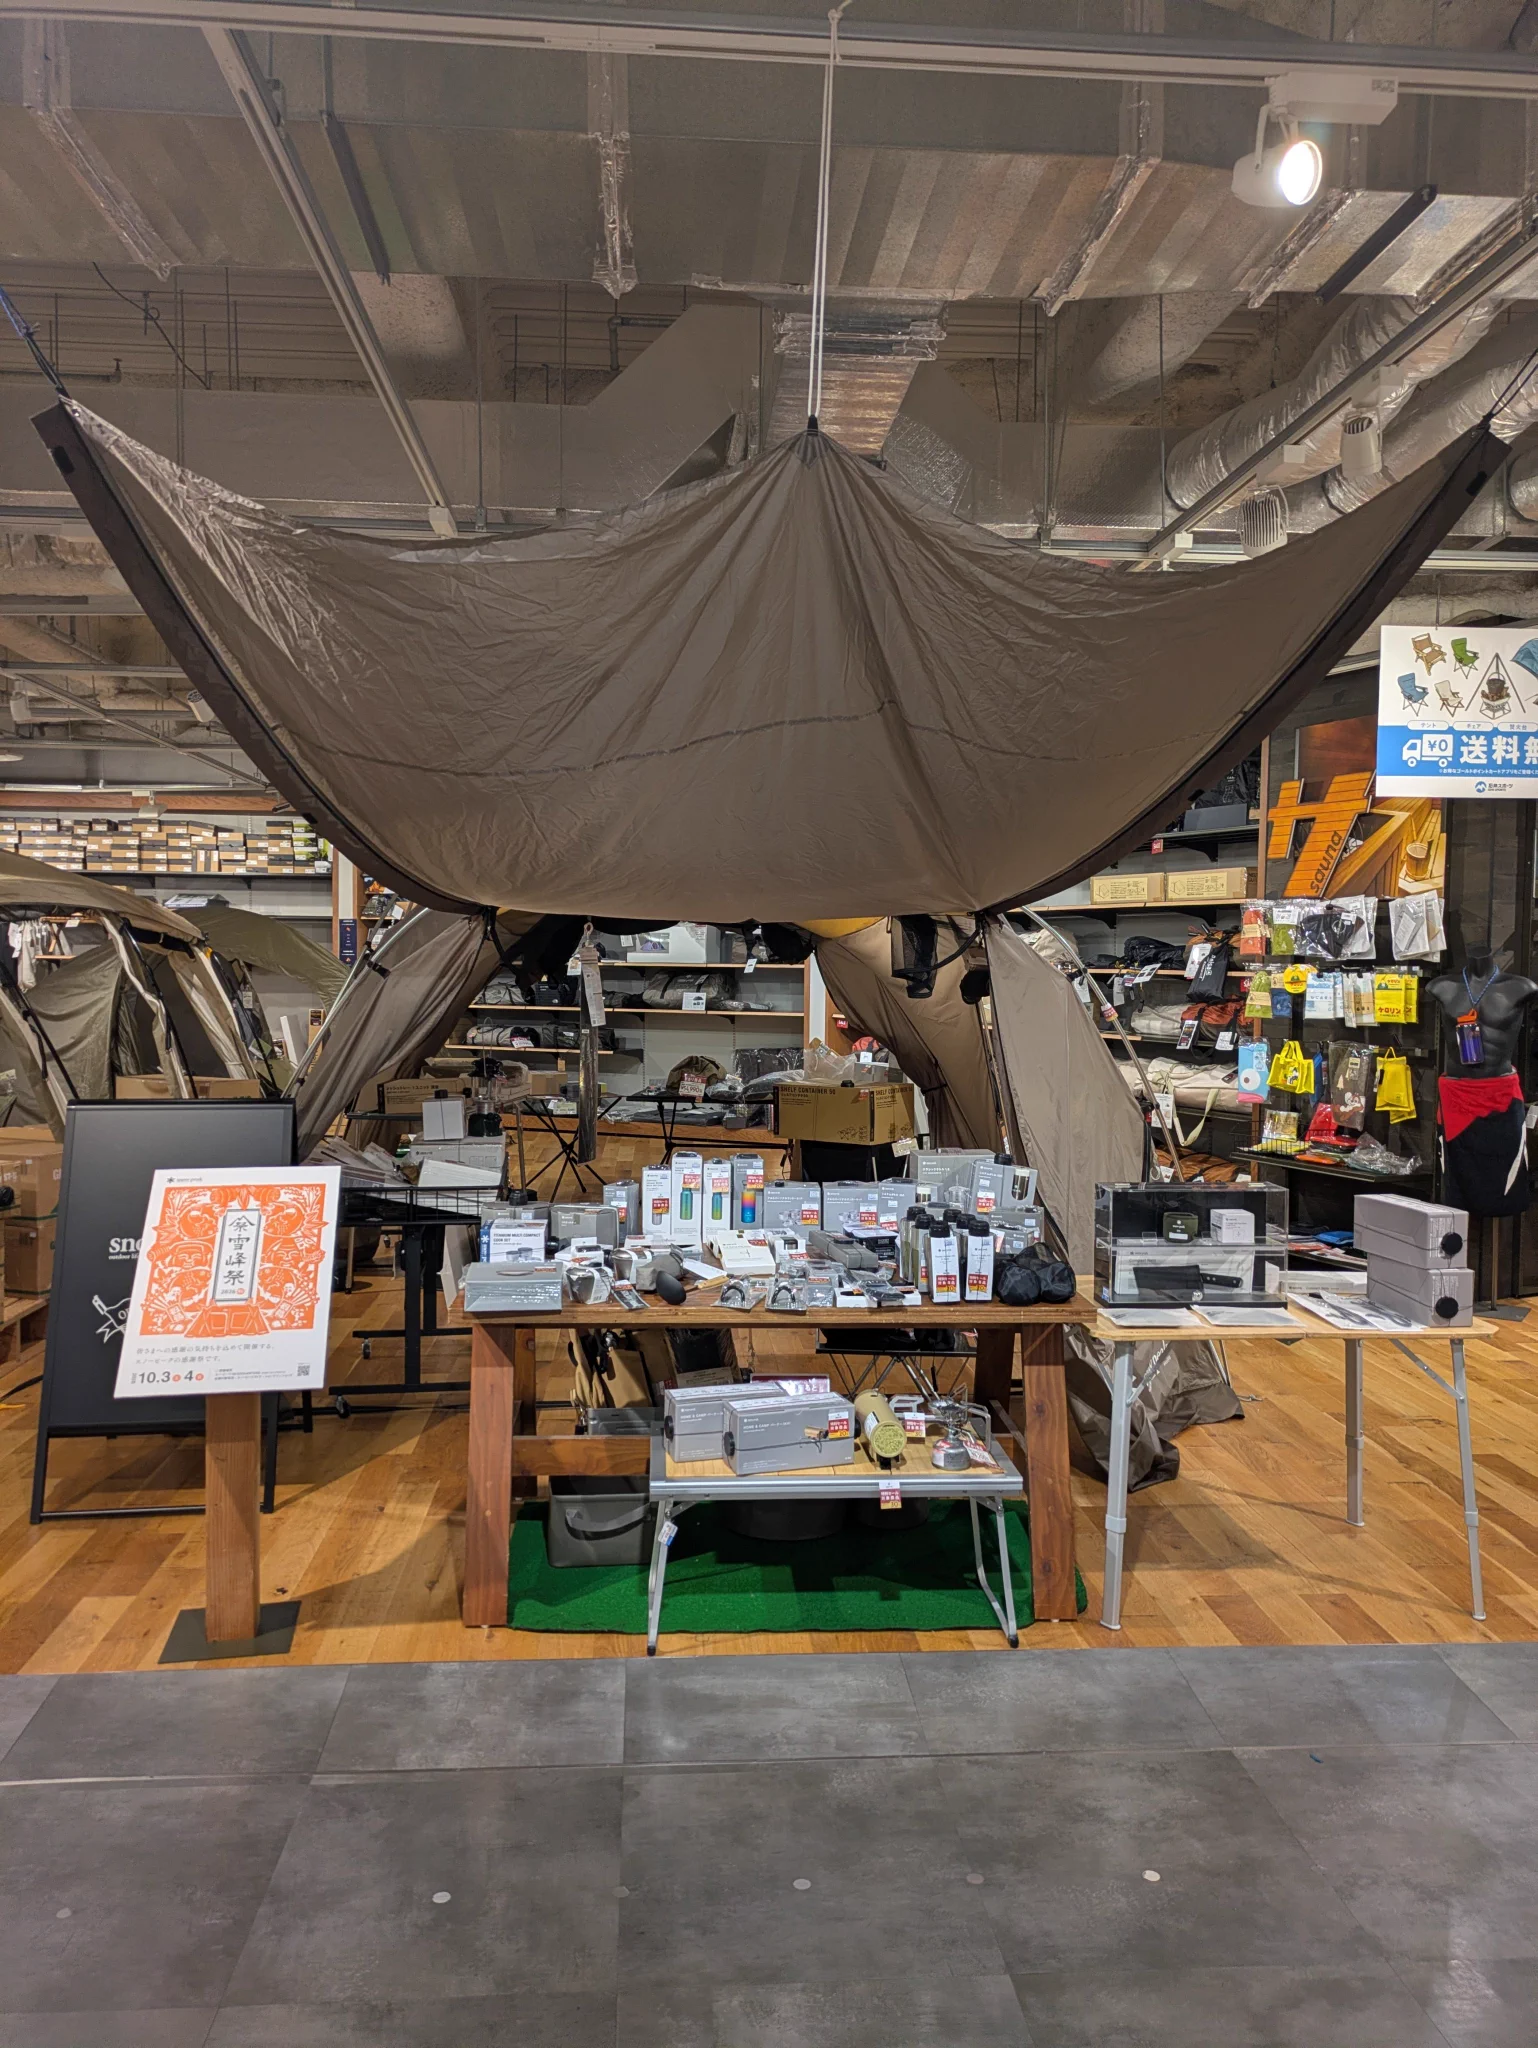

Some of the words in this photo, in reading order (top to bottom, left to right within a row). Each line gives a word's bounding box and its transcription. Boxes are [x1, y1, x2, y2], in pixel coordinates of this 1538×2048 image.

[1428, 739, 1448, 752] ¥0
[1310, 831, 1343, 893] sauna
[1378, 1006, 1402, 1015] ケロリン
[798, 1087, 828, 1095] CONTAINER
[138, 1371, 171, 1384] 10.3
[184, 1370, 194, 1382] 4
